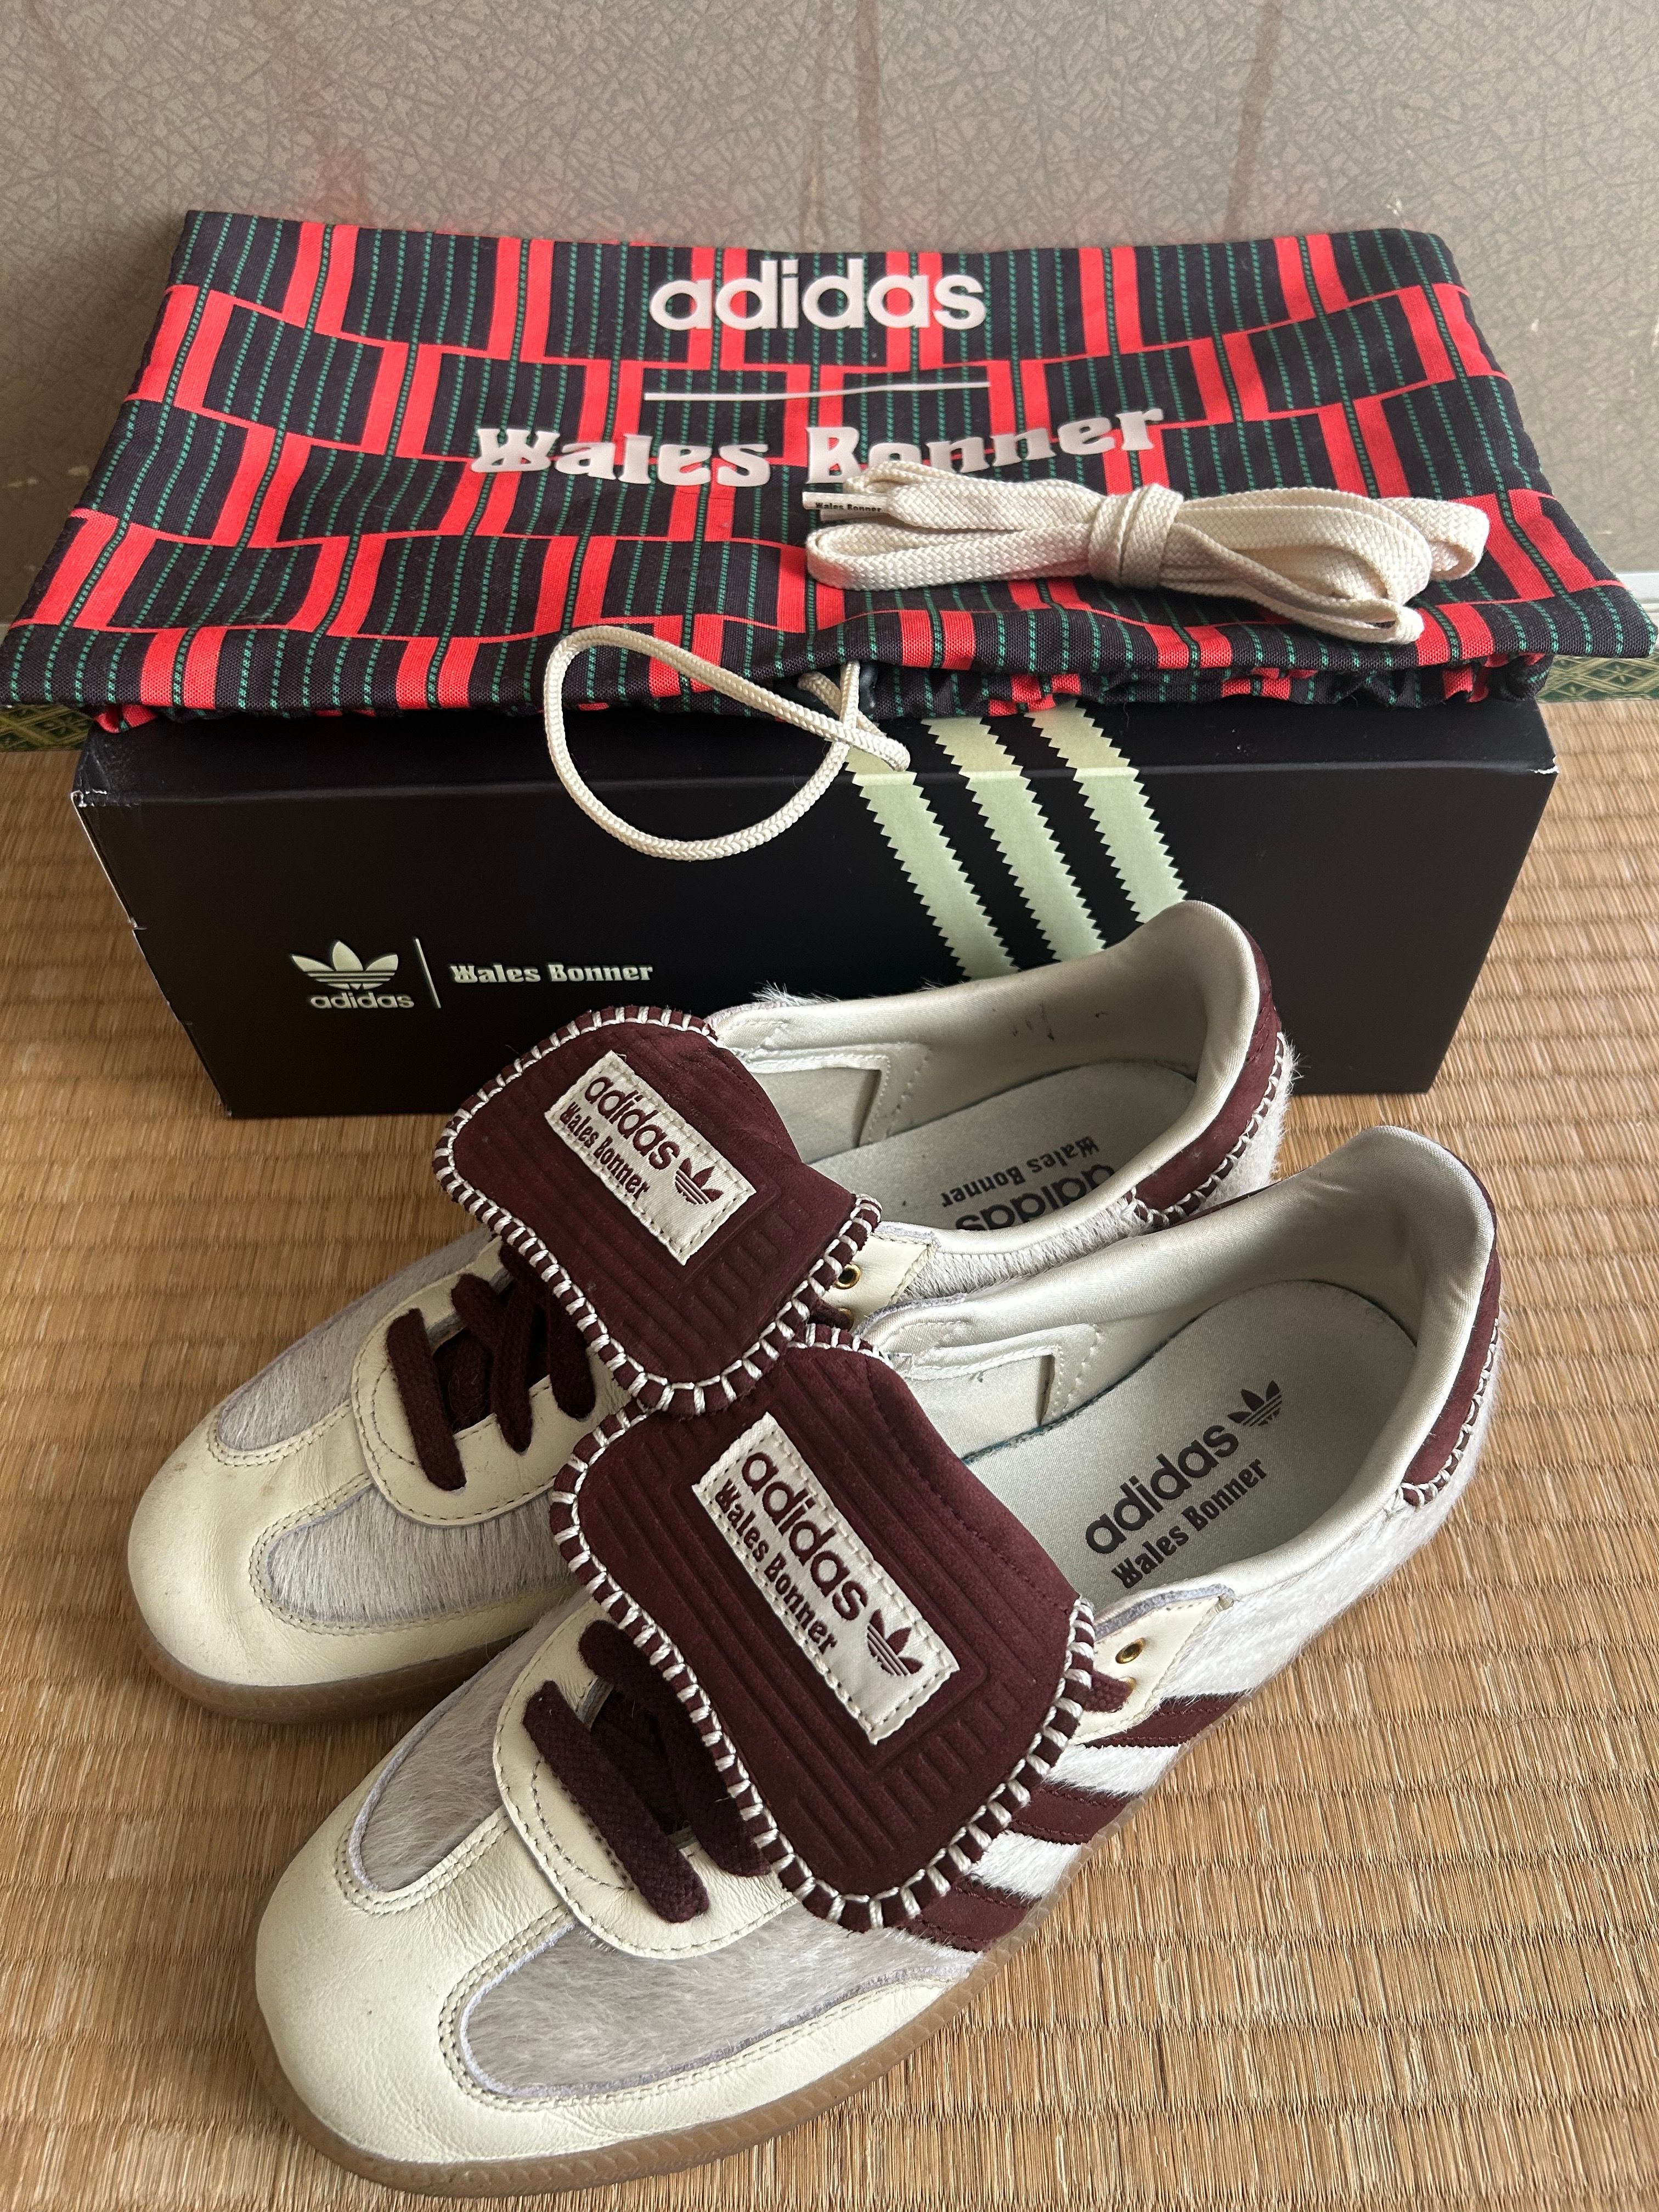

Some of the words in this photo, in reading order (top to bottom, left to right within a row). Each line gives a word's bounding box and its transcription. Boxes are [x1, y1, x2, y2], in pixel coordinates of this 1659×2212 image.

[650, 258, 986, 329] adidas
[470, 428, 771, 487] Wales
[816, 502, 844, 510] Wales
[847, 504, 882, 512] Bonner
[310, 992, 415, 1010] adidas
[449, 963, 541, 984] Wales
[548, 962, 654, 982] Bonner
[560, 1101, 600, 1148] Wales
[593, 1134, 651, 1199] Bonner
[584, 1076, 680, 1170] adidas
[1026, 1136, 1100, 1173] Wales
[941, 1166, 1026, 1207] Bonner
[1085, 1425, 1239, 1554] adidas
[1111, 1525, 1190, 1589] Wales
[1181, 1458, 1268, 1532] Bonner
[715, 1478, 770, 1563] Wales
[763, 1552, 838, 1655] Bonner
[741, 1452, 868, 1621] adidas
